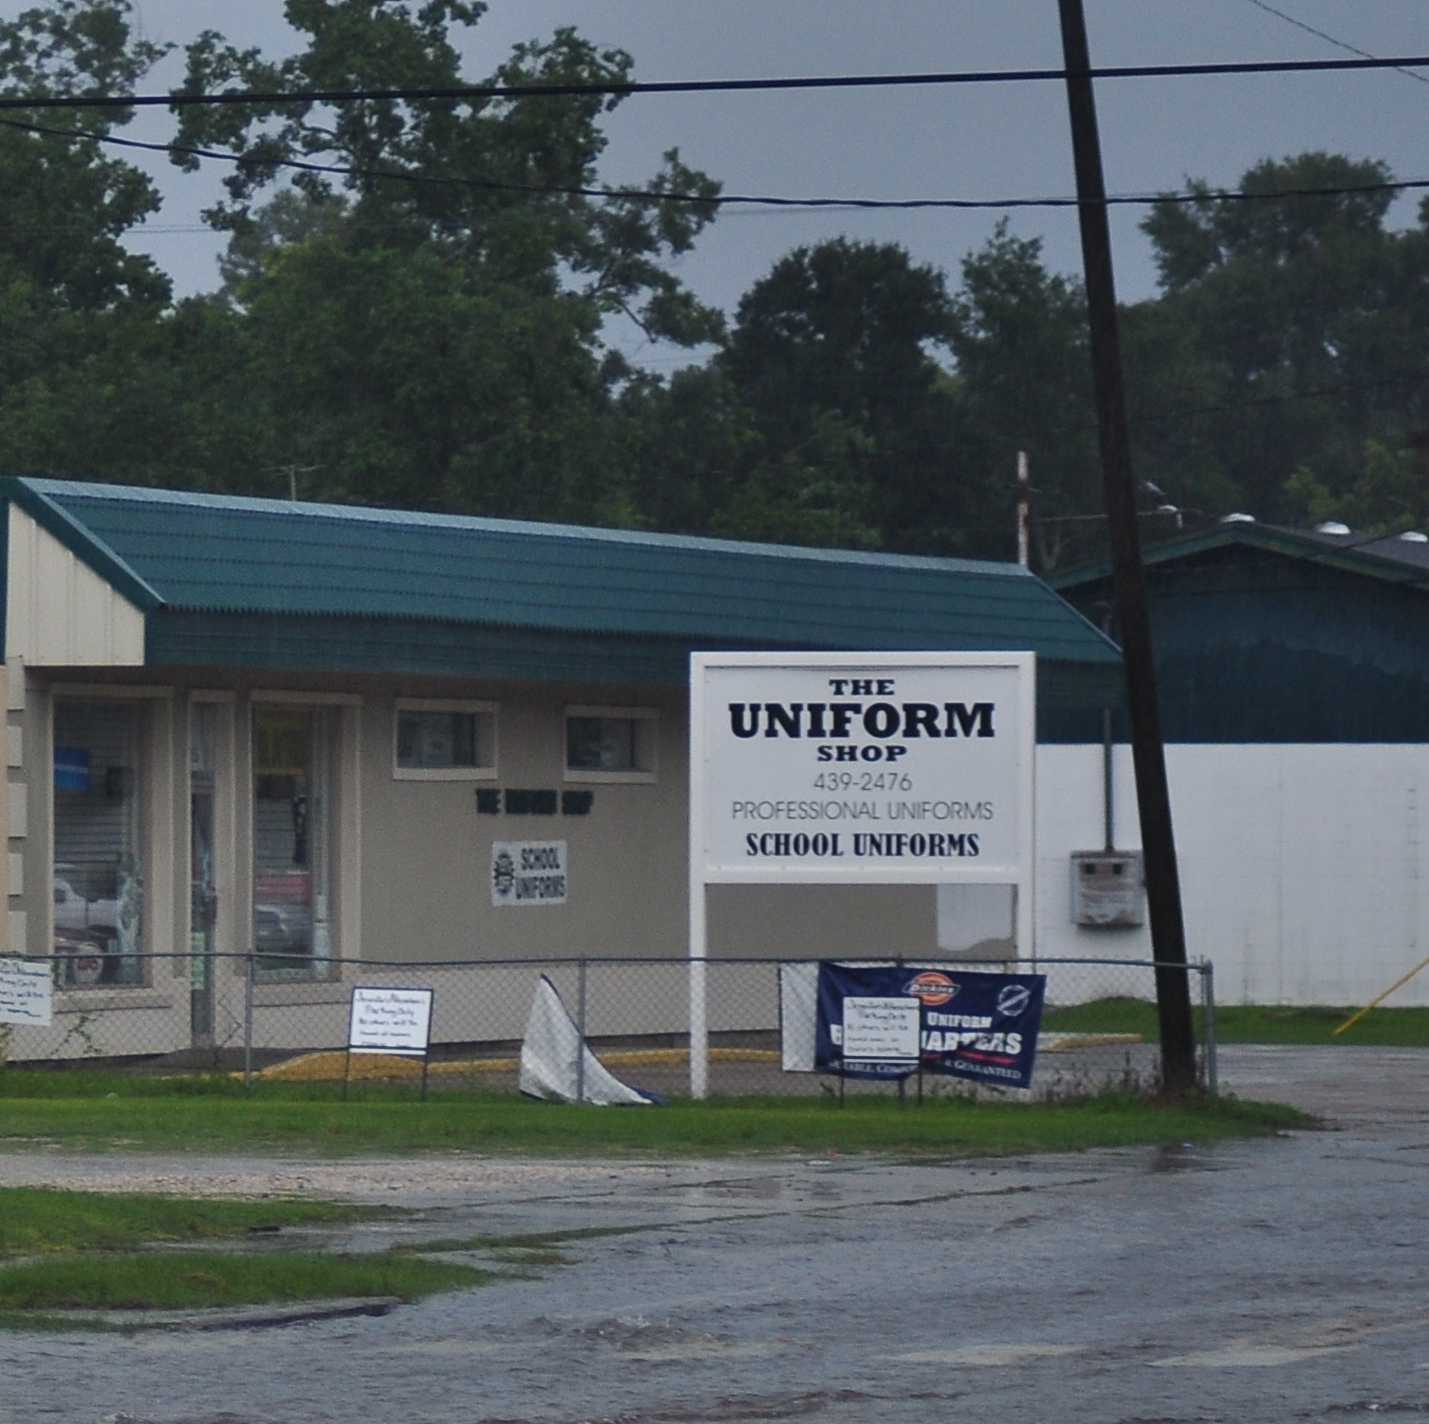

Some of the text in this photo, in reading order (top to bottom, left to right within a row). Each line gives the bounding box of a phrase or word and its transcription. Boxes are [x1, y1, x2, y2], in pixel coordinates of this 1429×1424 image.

[829, 679, 895, 696] THE
[728, 702, 995, 738] UNIFORM
[817, 745, 907, 762] SHOP
[814, 772, 912, 791] 439-2476
[732, 801, 994, 820] PROFESSIONAL UNIFORMS
[746, 832, 980, 857] SCHOOL UNIFORMS
[521, 847, 560, 870] SCHOOL
[516, 875, 566, 899] UNIFORMS
[927, 1011, 993, 1029] UNIFORM
